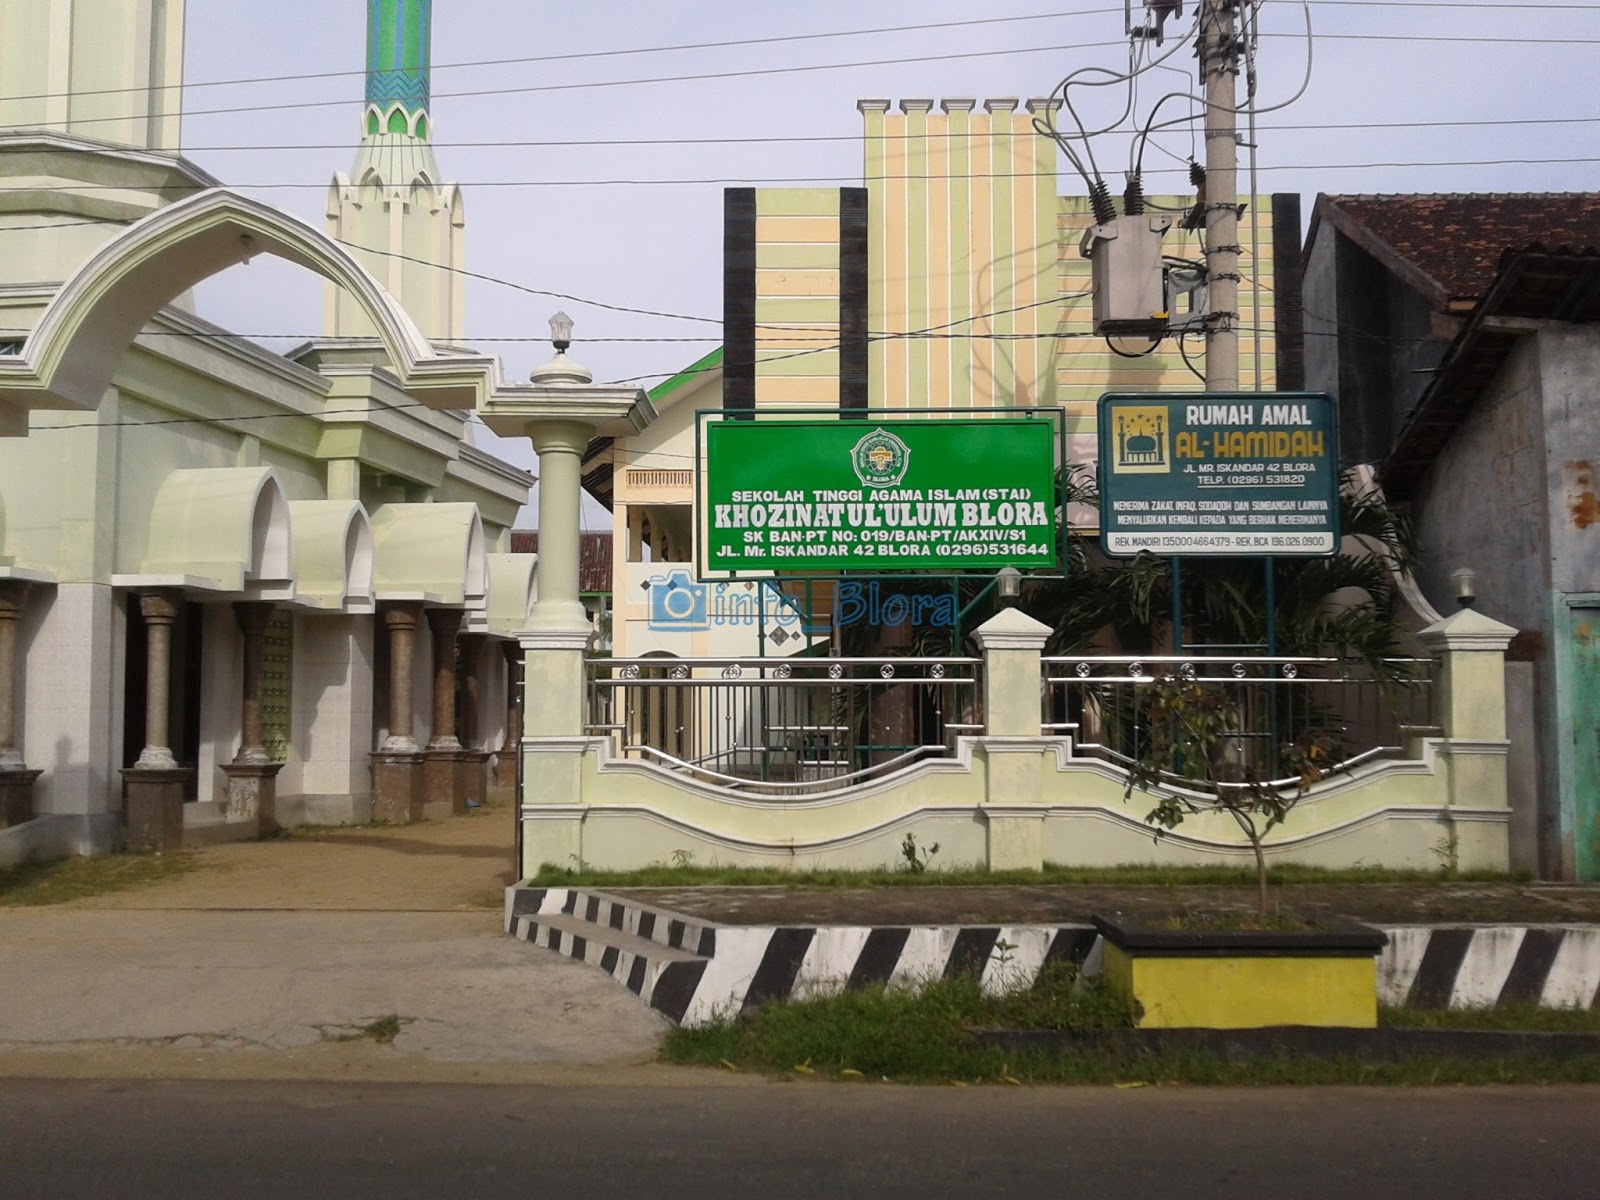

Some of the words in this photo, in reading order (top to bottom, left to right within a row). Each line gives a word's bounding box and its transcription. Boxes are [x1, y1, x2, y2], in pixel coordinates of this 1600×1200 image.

[1186, 405, 1253, 425] RUMAH
[1261, 404, 1312, 425] AMAL
[1175, 431, 1324, 458] AL-HAMIDAH
[1217, 463, 1264, 473] ISKANDAR
[1266, 463, 1280, 472] 42
[1283, 463, 1316, 472] BLORA
[1197, 475, 1224, 485] TELP.
[1228, 475, 1263, 485] (0296)
[1266, 475, 1305, 484] 531820
[732, 490, 804, 502] SEKOLAH
[813, 489, 863, 502] TINGGI
[869, 489, 923, 501] AGAMA
[928, 489, 980, 501] ISLAM
[982, 488, 1031, 501] (STAI)
[1113, 501, 1149, 511] MENERIMA
[1234, 501, 1249, 511] DAN
[1251, 500, 1296, 511] SUMBANGAN
[1297, 500, 1328, 510] LAINNYA
[961, 502, 1049, 527] BLORA
[1117, 515, 1167, 525] MENYALURKAN
[1168, 515, 1198, 525] KEMBALI
[1199, 515, 1226, 525] KEPADA
[1228, 515, 1247, 525] YANG
[1248, 515, 1277, 525] BERHAK
[1278, 514, 1327, 525] MENERIMANYA
[743, 531, 764, 543] SK
[769, 530, 827, 542] BAN-PT
[832, 530, 858, 542] NO:
[1132, 537, 1161, 546] MANDIRI
[1162, 537, 1230, 547] 1350004664379
[1254, 537, 1269, 546] BCA
[716, 545, 741, 557] JL.
[744, 545, 767, 557] Mr.
[771, 545, 848, 557] ISKANDAR
[853, 545, 875, 556] 42
[878, 544, 931, 556] BLORA
